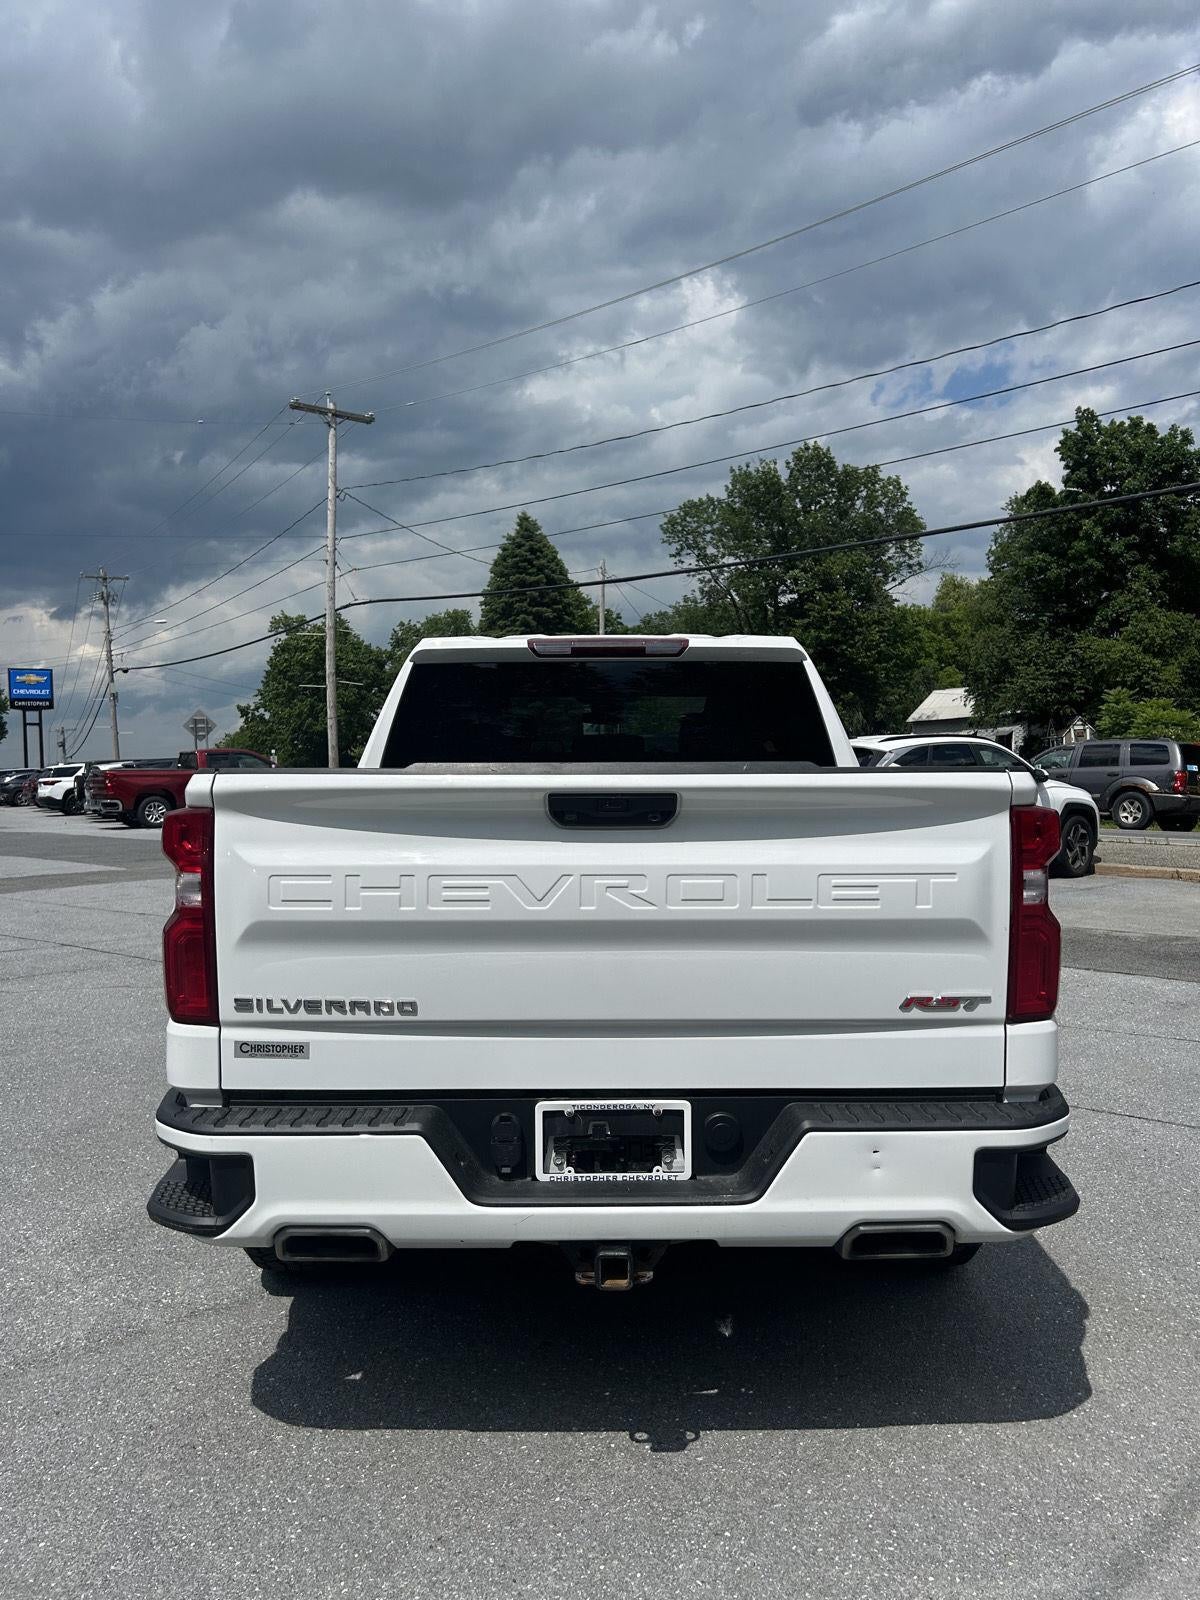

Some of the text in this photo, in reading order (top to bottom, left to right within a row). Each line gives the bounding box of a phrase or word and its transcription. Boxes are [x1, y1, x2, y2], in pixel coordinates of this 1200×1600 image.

[267, 873, 958, 911] CHEVROLET
[234, 998, 418, 1016] SILVERADO
[899, 995, 992, 1013] RST
[239, 1042, 305, 1053] CHRISTOPHER
